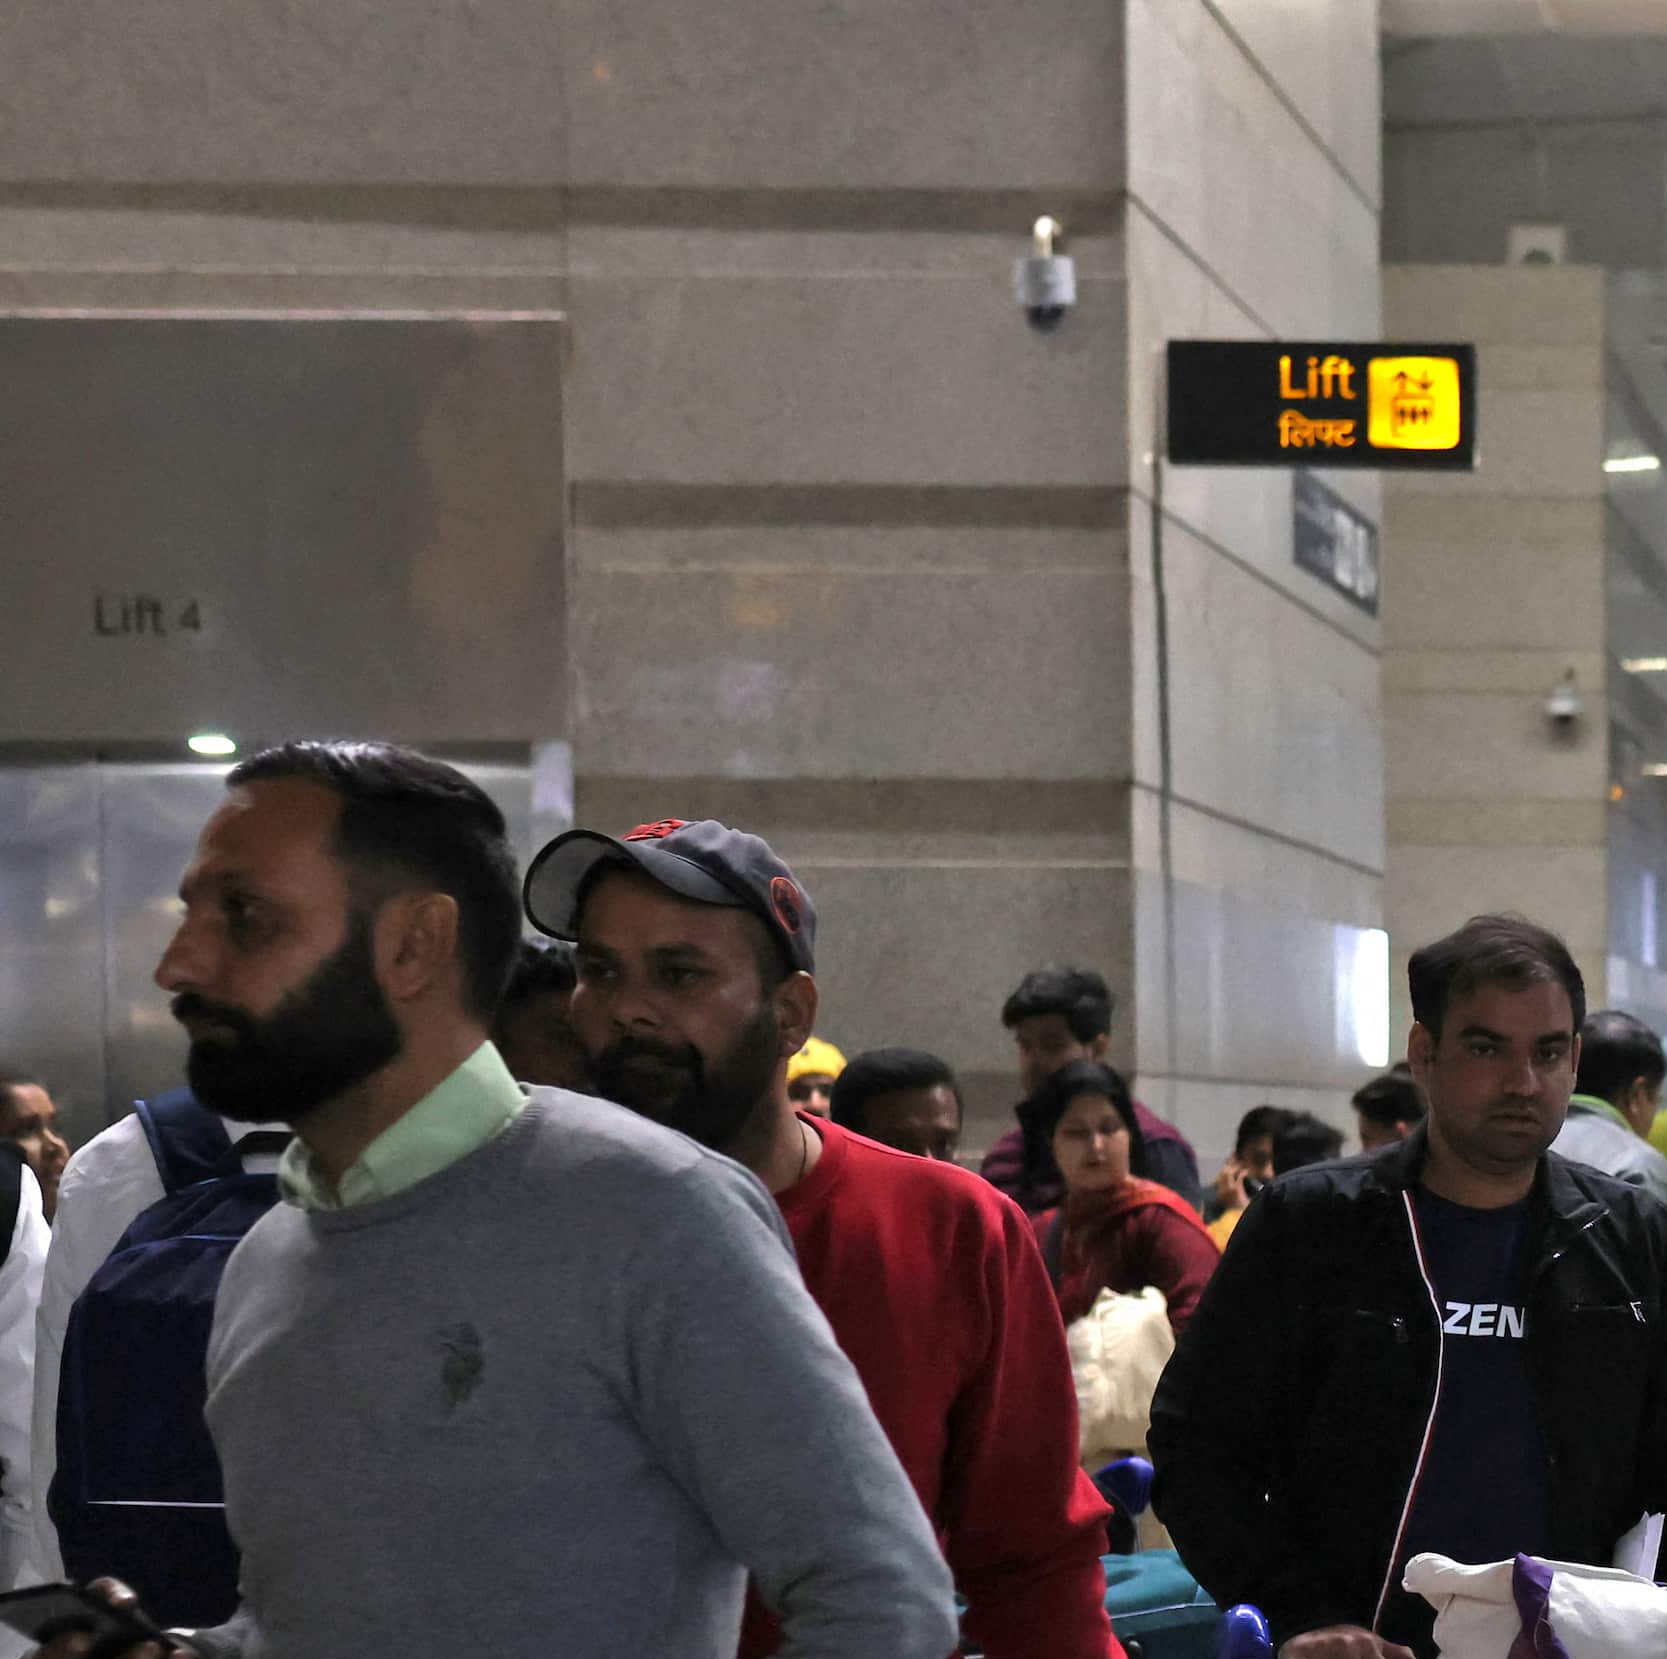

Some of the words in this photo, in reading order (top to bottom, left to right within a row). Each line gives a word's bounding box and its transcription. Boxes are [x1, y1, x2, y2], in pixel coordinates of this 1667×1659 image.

[1279, 355, 1357, 399] Lift
[95, 594, 168, 638] Lift
[180, 598, 201, 634] 4
[1443, 1300, 1526, 1339] ZEN
